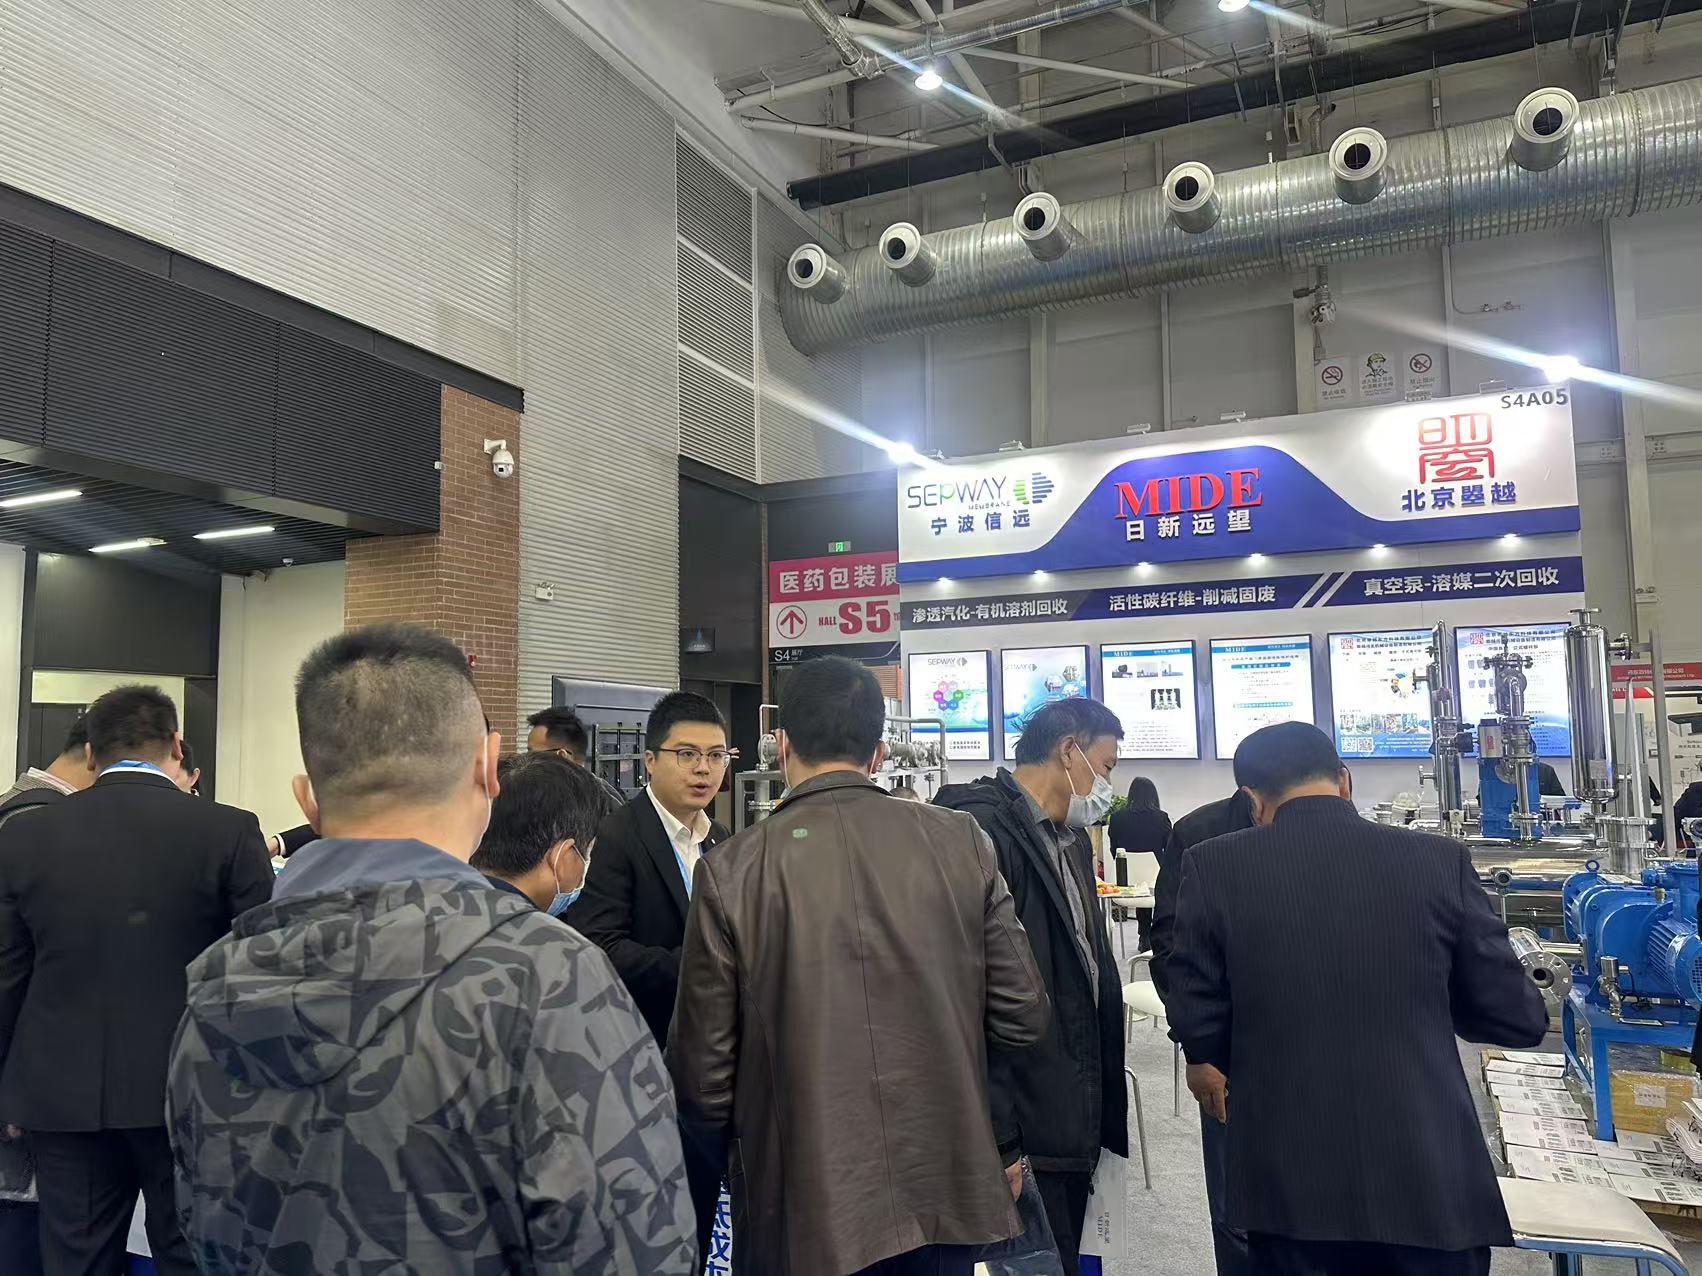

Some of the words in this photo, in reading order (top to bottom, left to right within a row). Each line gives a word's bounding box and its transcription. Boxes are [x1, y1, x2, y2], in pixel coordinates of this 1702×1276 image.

[1501, 388, 1568, 409] S4A05
[907, 476, 1007, 508] SEPWAY
[1114, 468, 1263, 519] MIDE
[930, 509, 1030, 536] 宁波信远
[1126, 509, 1251, 541] 日新远望
[1364, 567, 1560, 596] 真空泵-溶媒二次回收
[912, 598, 1068, 623] 渗透汽化-有机溶剂回收
[1109, 586, 1276, 611] 活性碳纤维-削减固废
[819, 616, 837, 626] HALL
[838, 600, 891, 634] S5
[774, 649, 790, 661] S4
